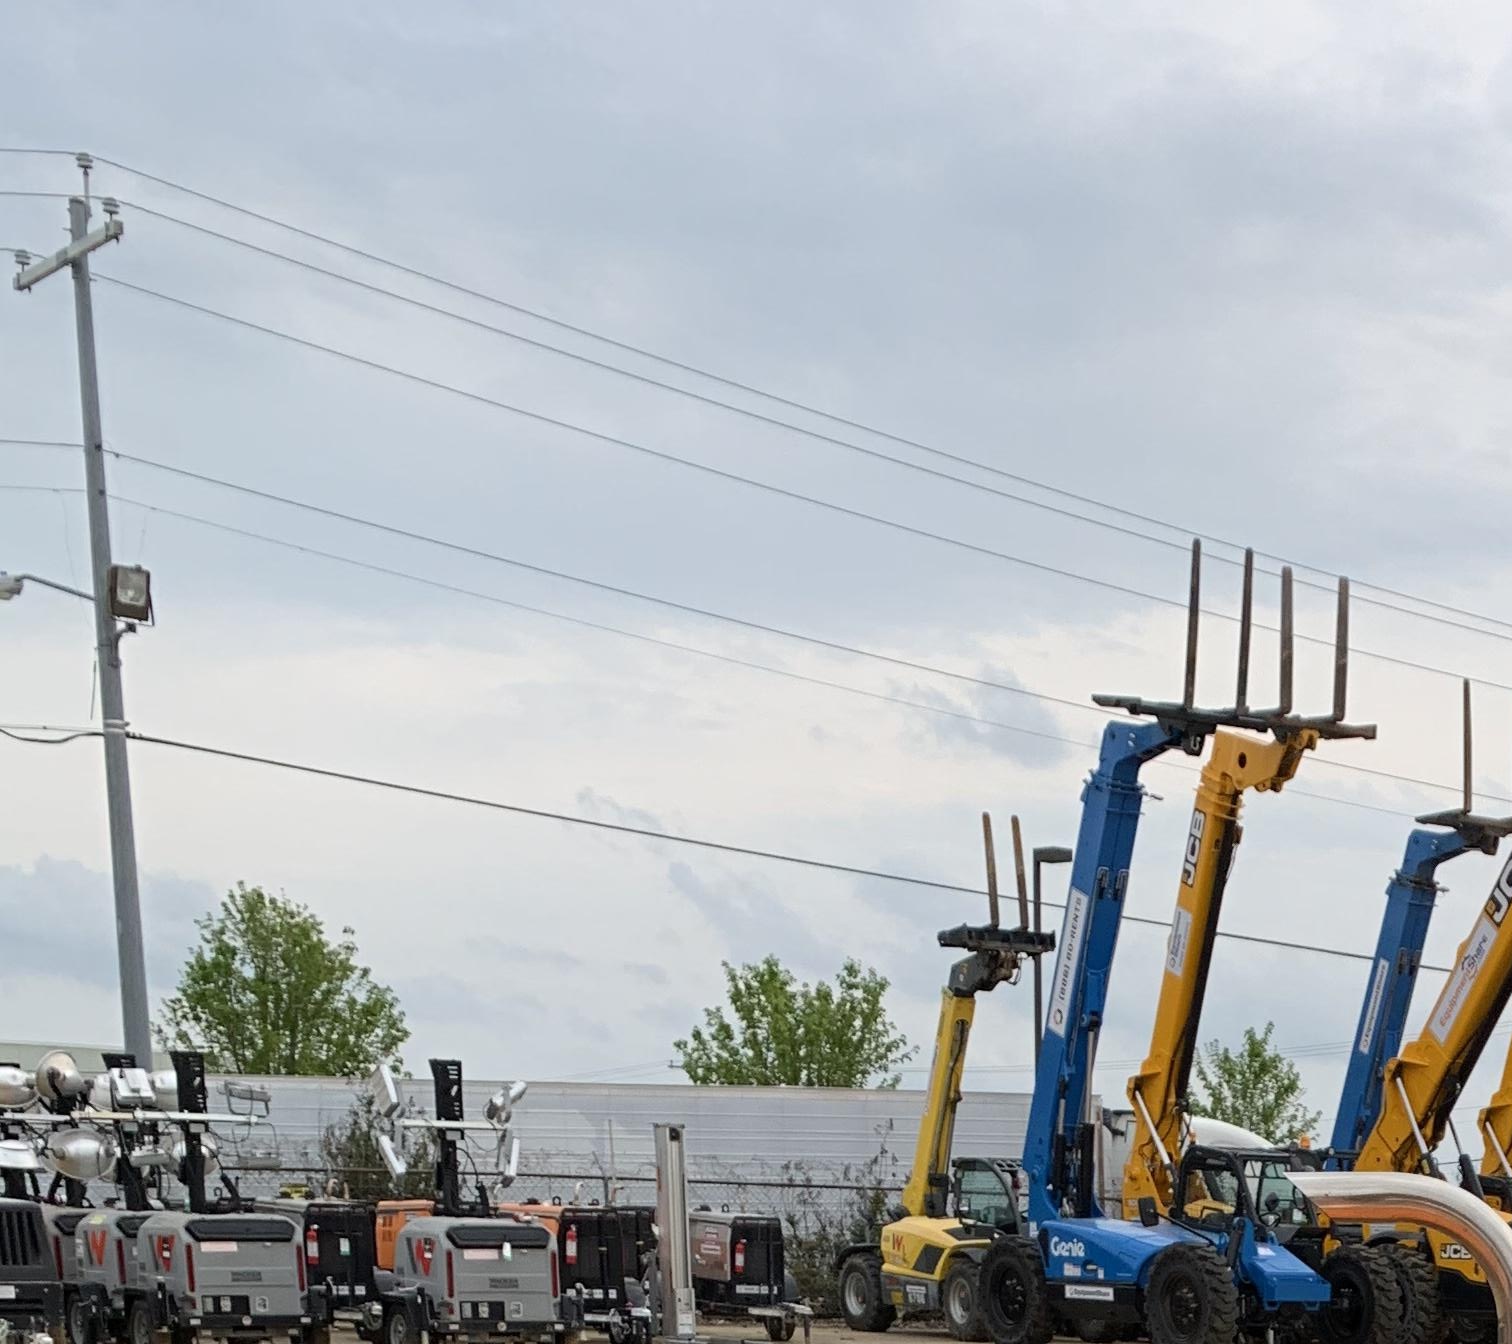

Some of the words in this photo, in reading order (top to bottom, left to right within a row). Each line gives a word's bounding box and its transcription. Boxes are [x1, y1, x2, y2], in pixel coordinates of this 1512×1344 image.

[1182, 809, 1206, 887] JCB
[1051, 1236, 1084, 1257] Genie
[1440, 1244, 1472, 1259] JCB
